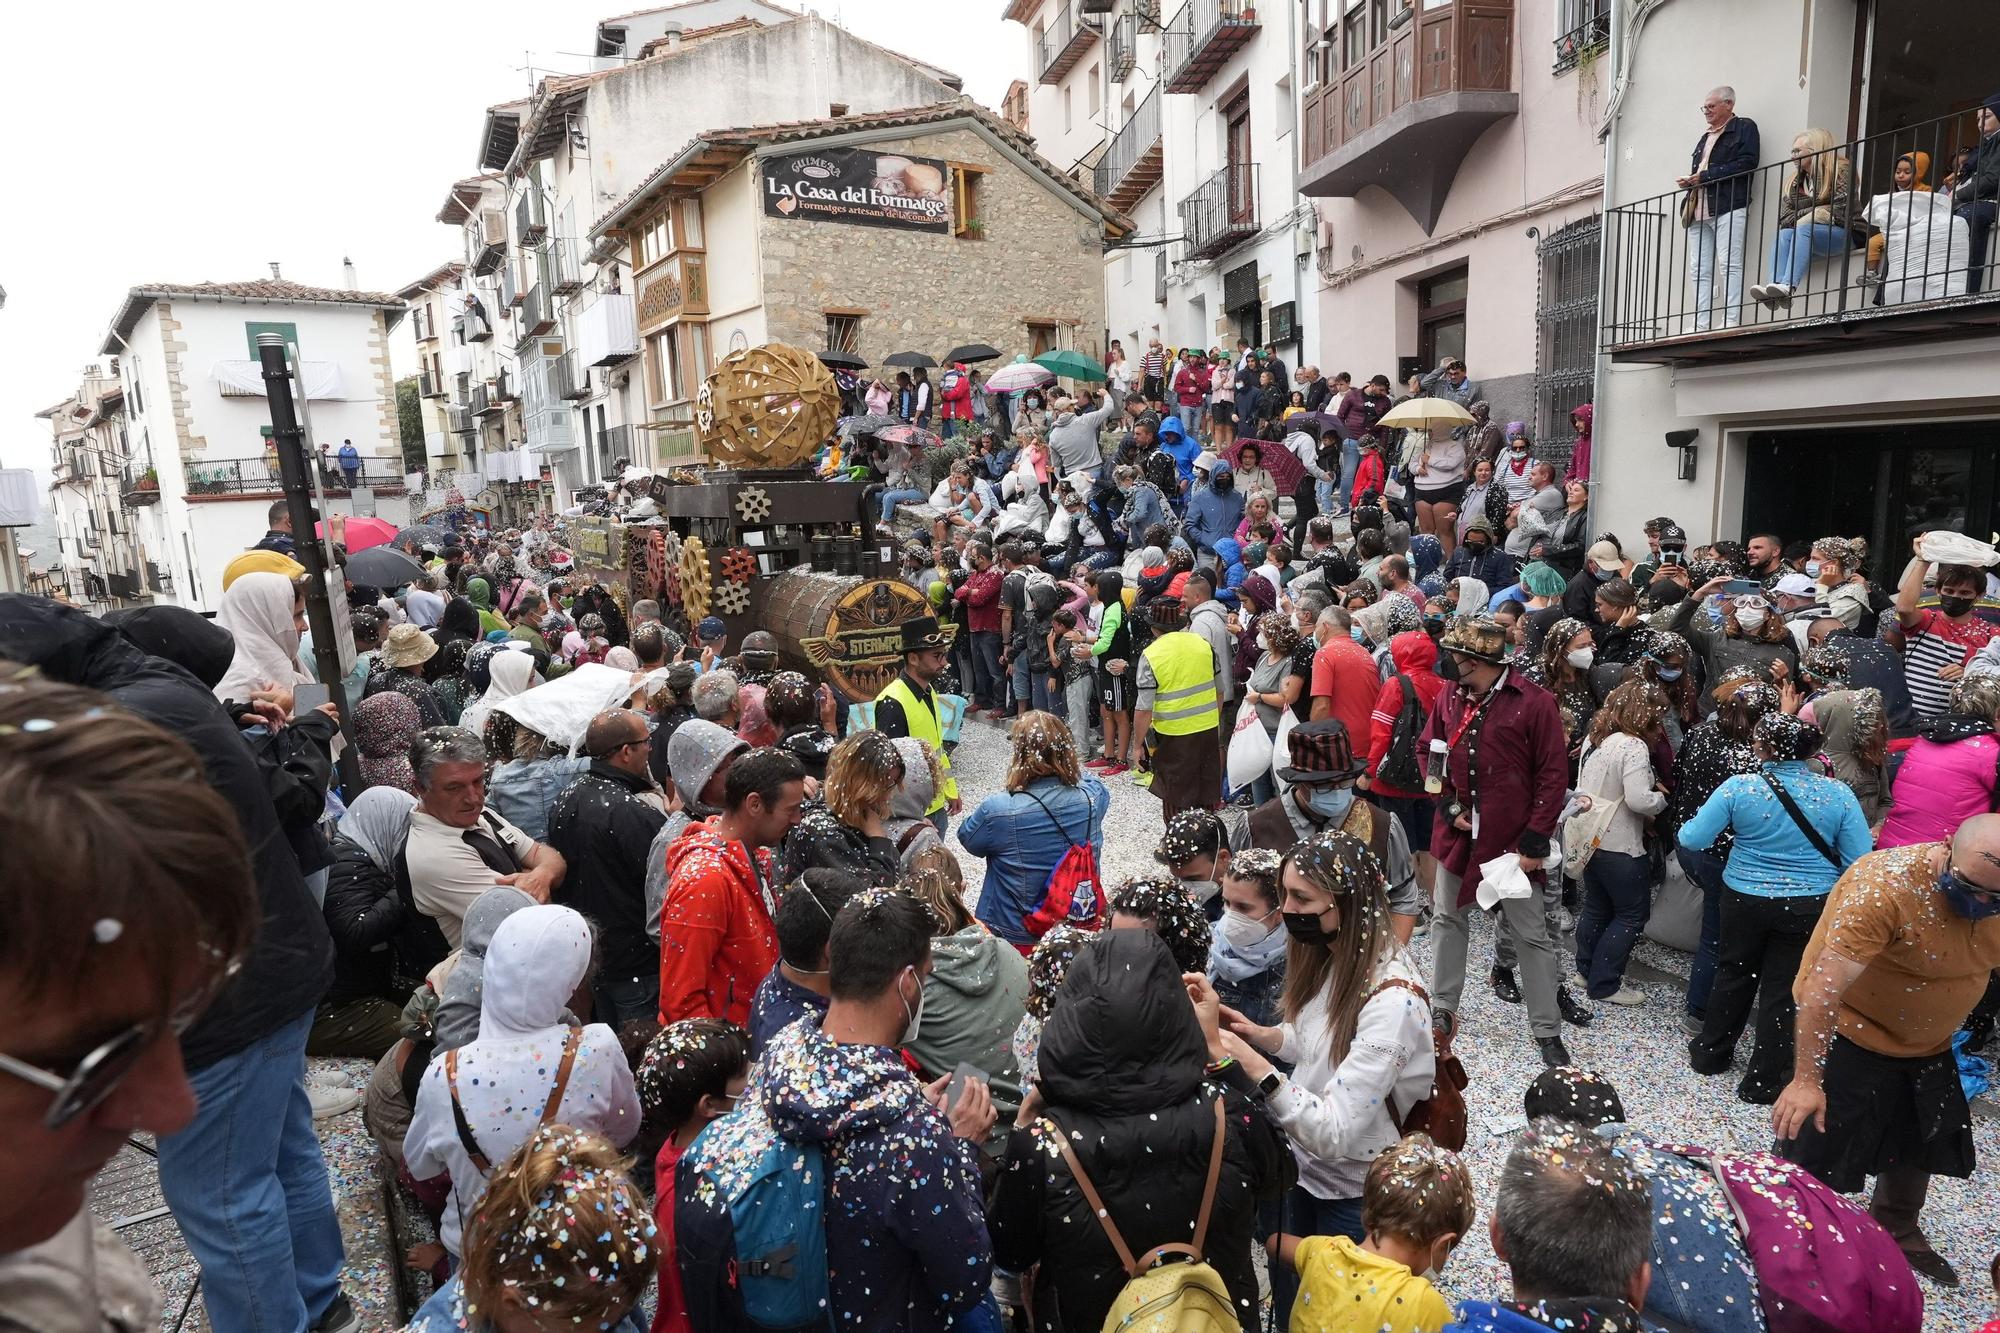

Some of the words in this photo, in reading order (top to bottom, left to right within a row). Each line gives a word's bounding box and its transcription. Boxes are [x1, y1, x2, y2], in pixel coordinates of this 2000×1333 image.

[767, 177, 792, 195] La
[795, 180, 839, 201] Casa
[840, 185, 868, 204] del
[869, 188, 945, 217] Formatge
[799, 200, 847, 214] Formatges
[848, 205, 885, 217] artesans
[886, 210, 897, 219] de
[898, 211, 907, 220] la
[908, 213, 945, 223] comarca
